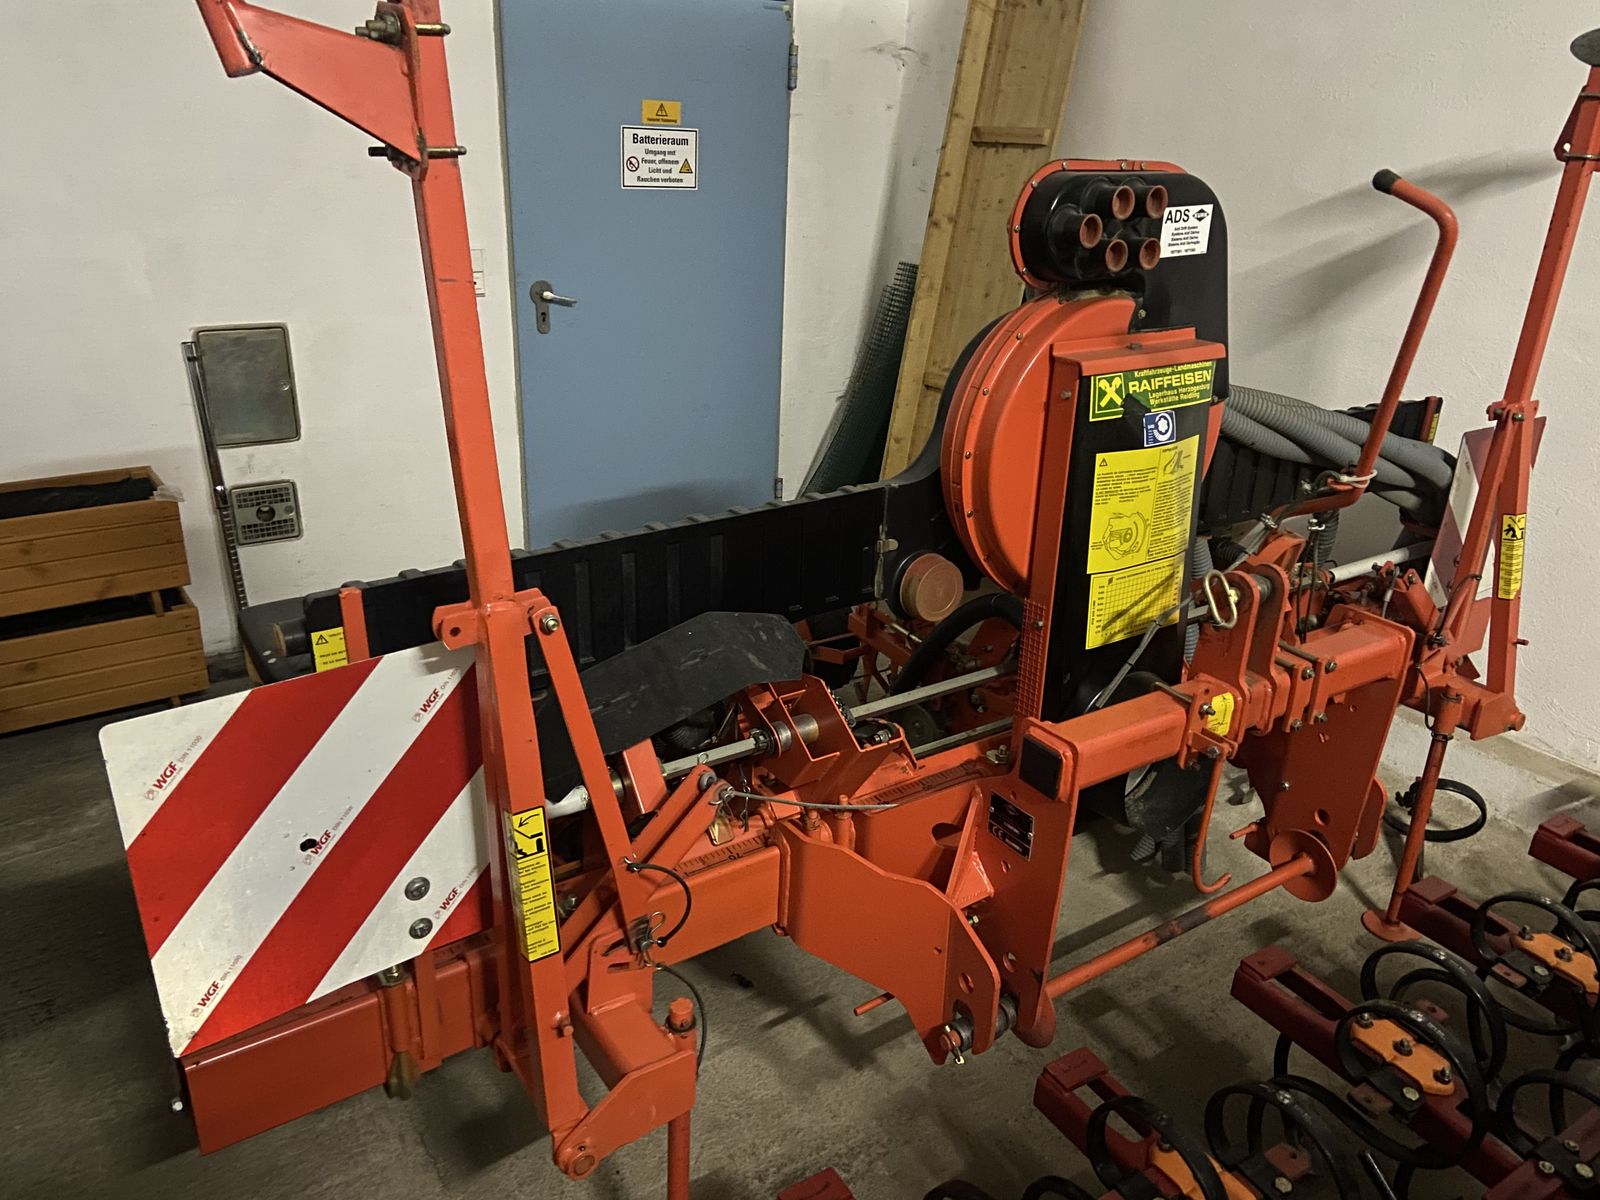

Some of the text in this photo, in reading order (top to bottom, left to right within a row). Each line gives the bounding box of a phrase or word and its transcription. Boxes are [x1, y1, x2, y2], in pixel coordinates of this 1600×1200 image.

[632, 133, 689, 146] Batterieraum
[641, 157, 658, 165] Feuer,
[644, 148, 667, 157] Umgang
[636, 175, 660, 183] Rauchen
[1164, 208, 1190, 224] ADS
[1128, 369, 1212, 394] RAIFFEISEN
[1148, 383, 1210, 399] Lagerhaus Herzogenburg
[419, 688, 440, 713] WGF
[152, 761, 177, 789] WGF
[310, 829, 331, 855] WGF
[439, 886, 459, 911] WGF
[197, 980, 221, 1007] WGF
